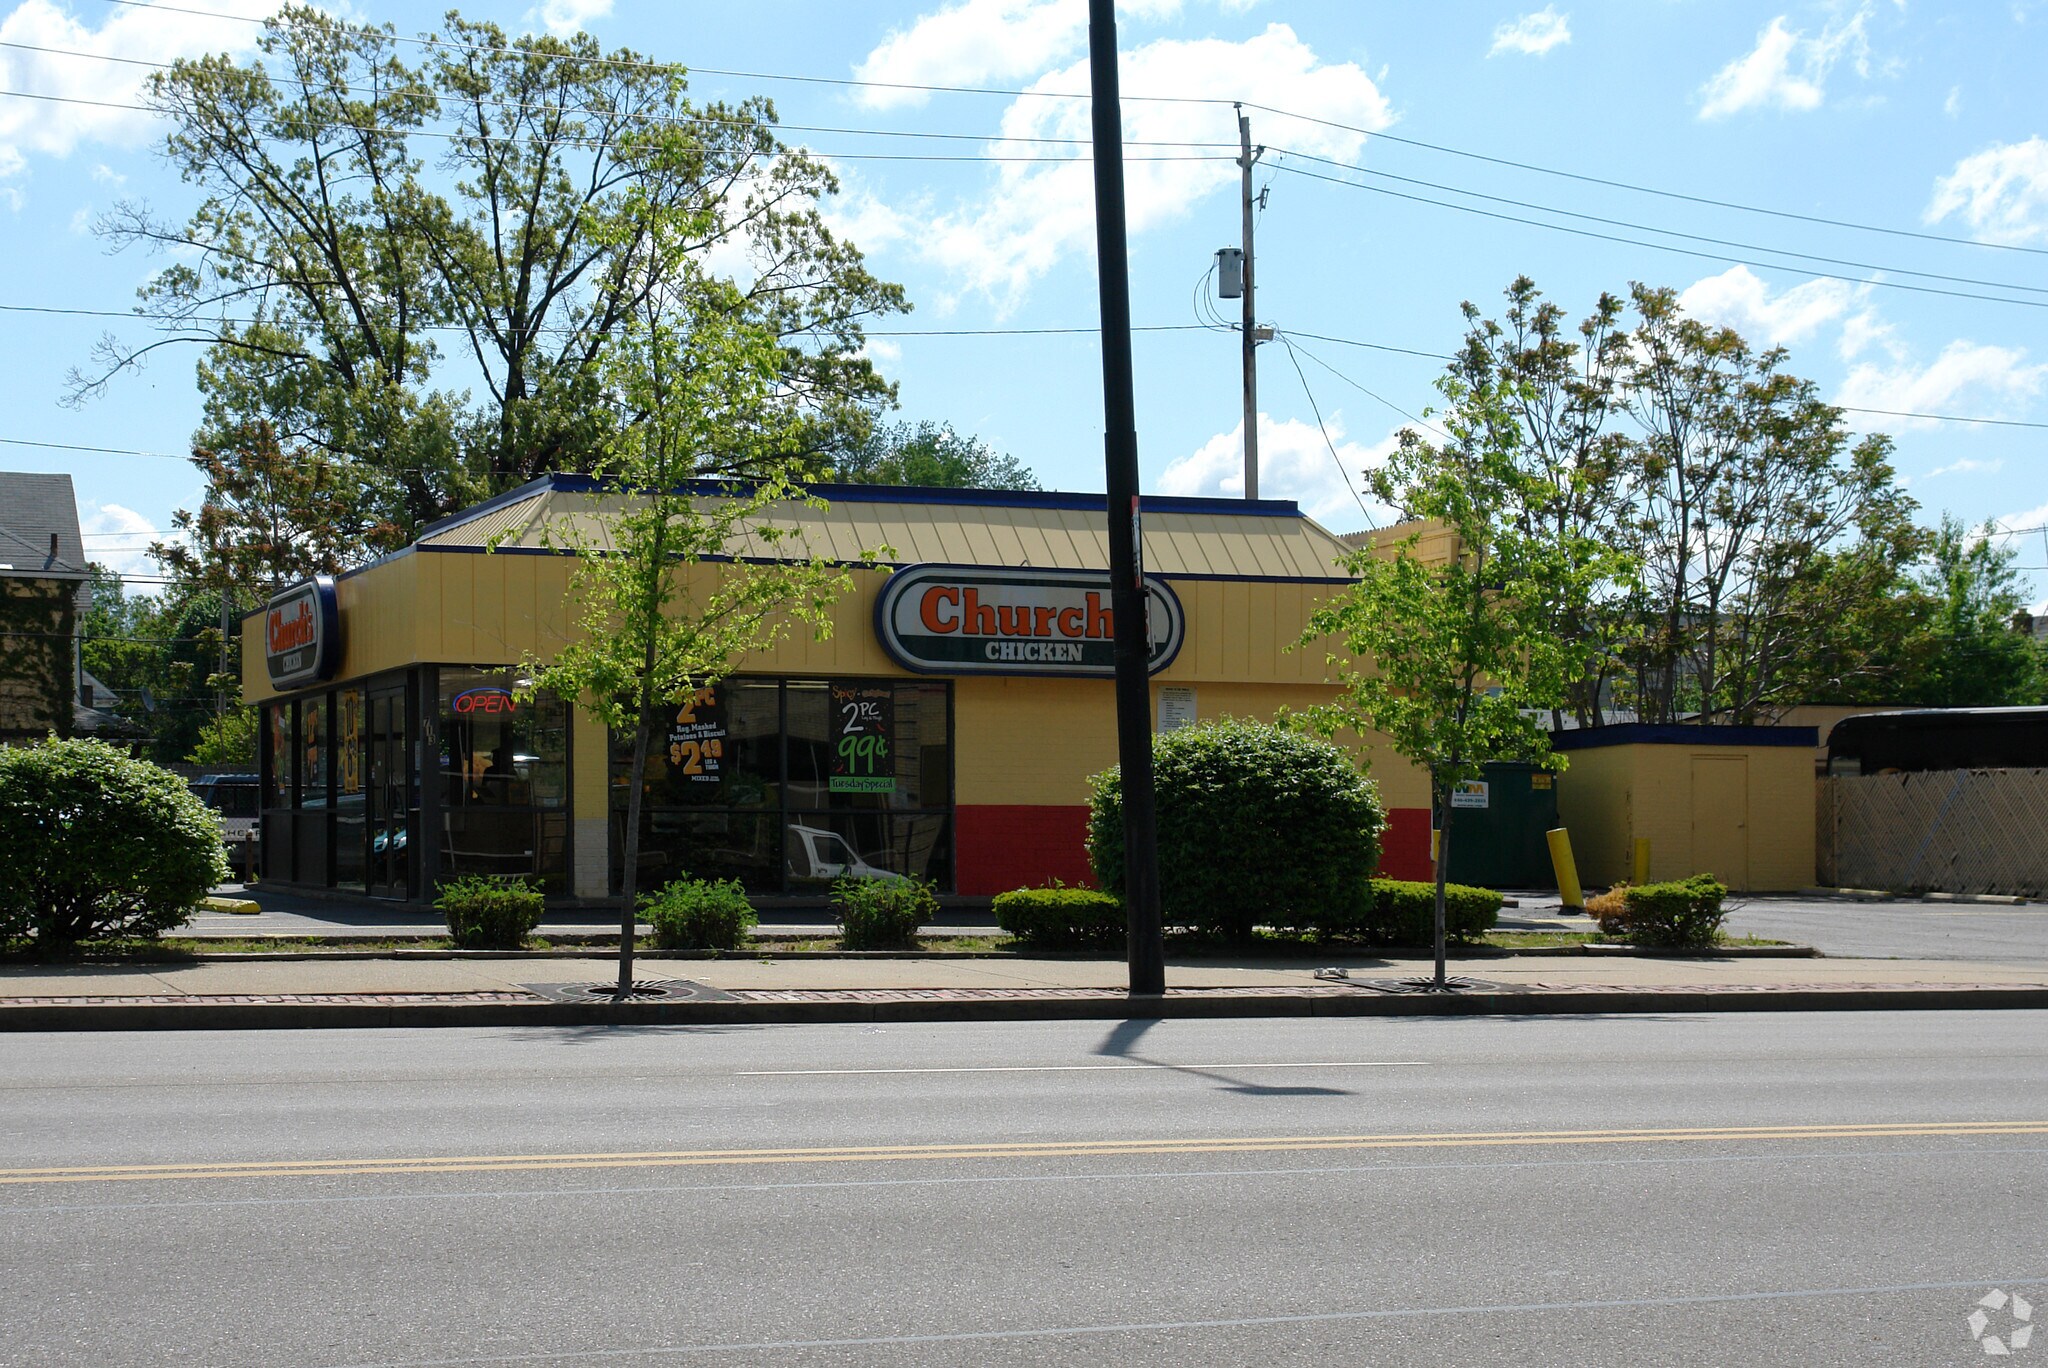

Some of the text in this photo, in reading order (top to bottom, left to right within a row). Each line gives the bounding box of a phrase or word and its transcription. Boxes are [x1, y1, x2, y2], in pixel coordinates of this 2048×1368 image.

[920, 586, 1148, 638] Church
[984, 641, 1083, 662] CHICKEN
[455, 695, 516, 713] OPEN
[691, 721, 717, 731] Mashed
[668, 733, 697, 742] Potatoes
[703, 729, 726, 738] Biscuit
[831, 778, 893, 792] Tuesday Special
